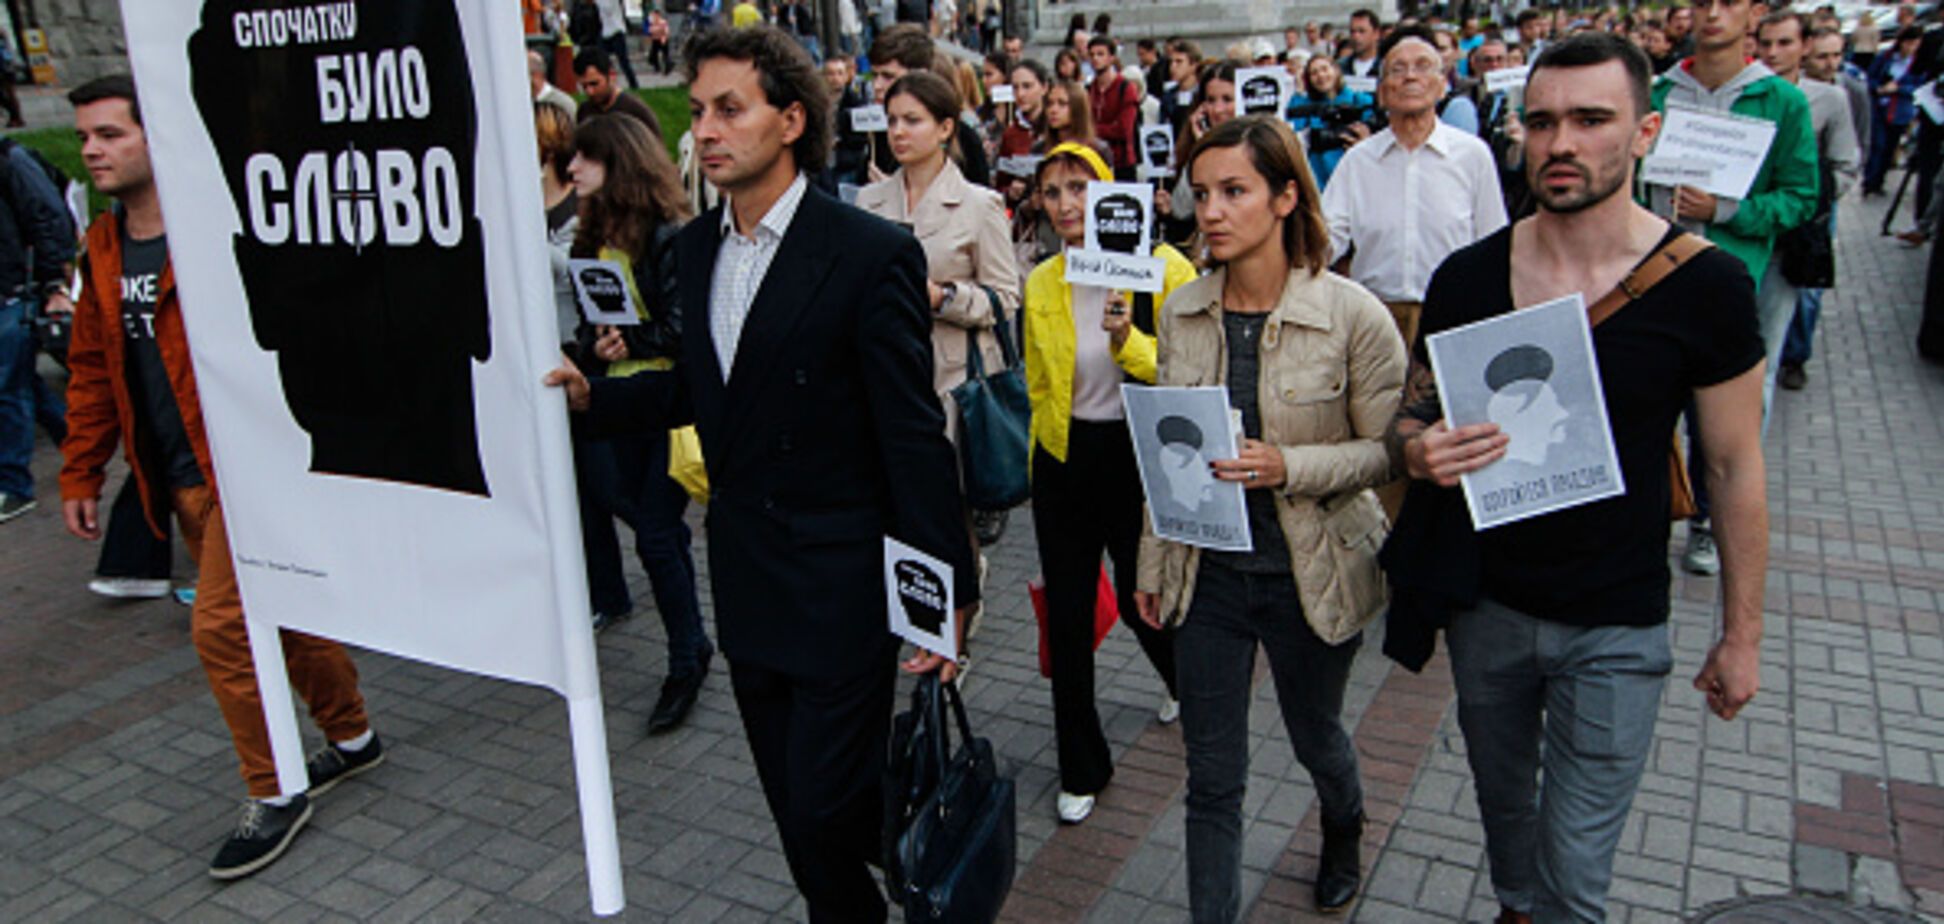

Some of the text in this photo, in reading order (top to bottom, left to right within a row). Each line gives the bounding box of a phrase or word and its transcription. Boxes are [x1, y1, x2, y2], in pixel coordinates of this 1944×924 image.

[233, 2, 357, 47] СПОЧАТКУ
[315, 46, 431, 123] БУЛО
[245, 146, 463, 247] СЛОВО
